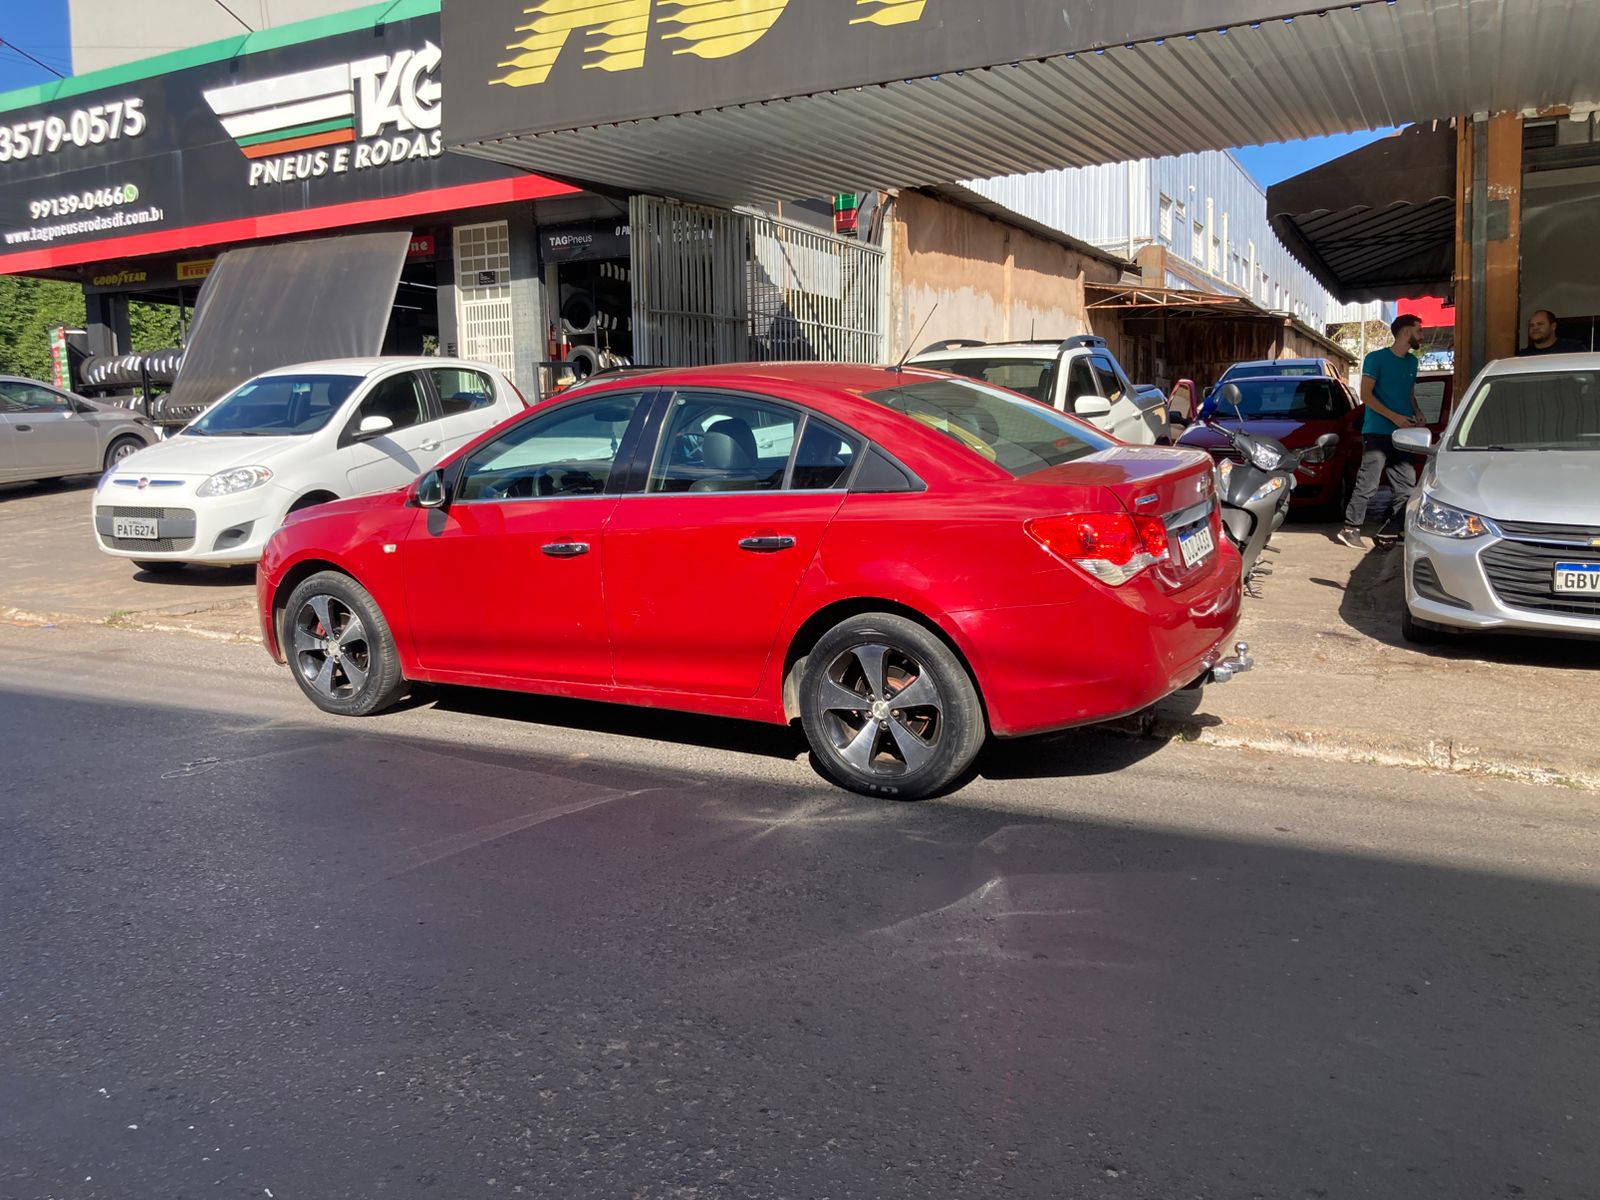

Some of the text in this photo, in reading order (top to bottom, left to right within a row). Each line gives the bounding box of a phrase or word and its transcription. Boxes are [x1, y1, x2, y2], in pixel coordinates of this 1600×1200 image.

[0, 97, 147, 162] 3579-0575
[249, 130, 442, 186] PNEUS E RODAS
[30, 187, 123, 220] 99139-0466
[549, 235, 593, 247] TAGPneus
[93, 270, 147, 286] GOODYEAR
